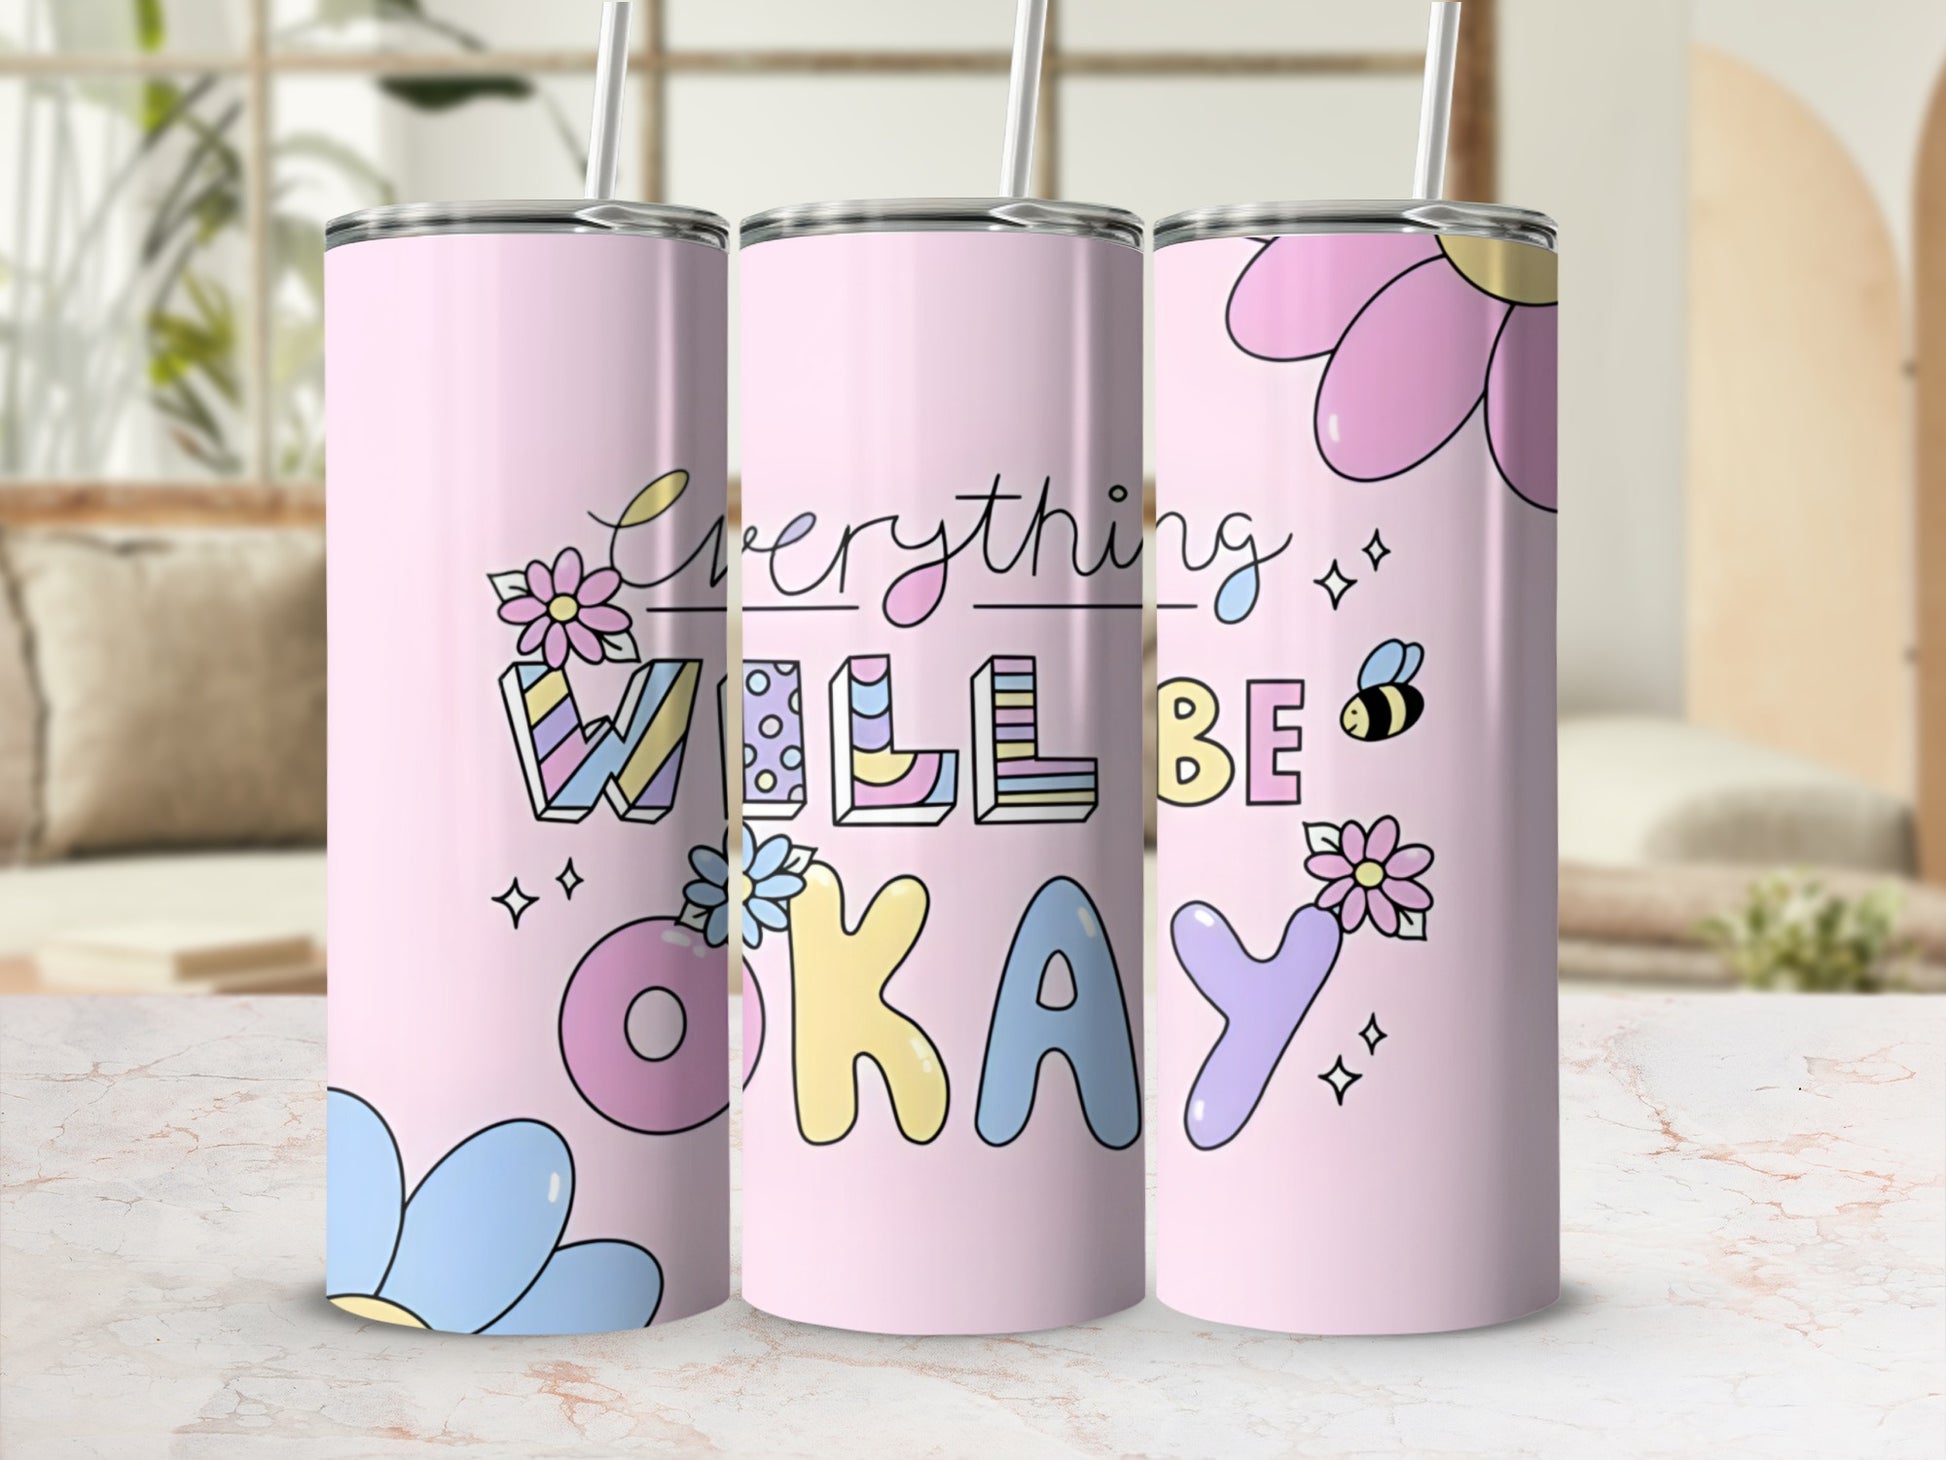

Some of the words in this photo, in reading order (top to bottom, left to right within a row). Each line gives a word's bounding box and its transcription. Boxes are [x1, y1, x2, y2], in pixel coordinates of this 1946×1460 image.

[587, 469, 1293, 628] Everything
[499, 653, 1099, 827] WILL
[1156, 676, 1305, 808] BE
[558, 860, 1343, 1151] OKAY
